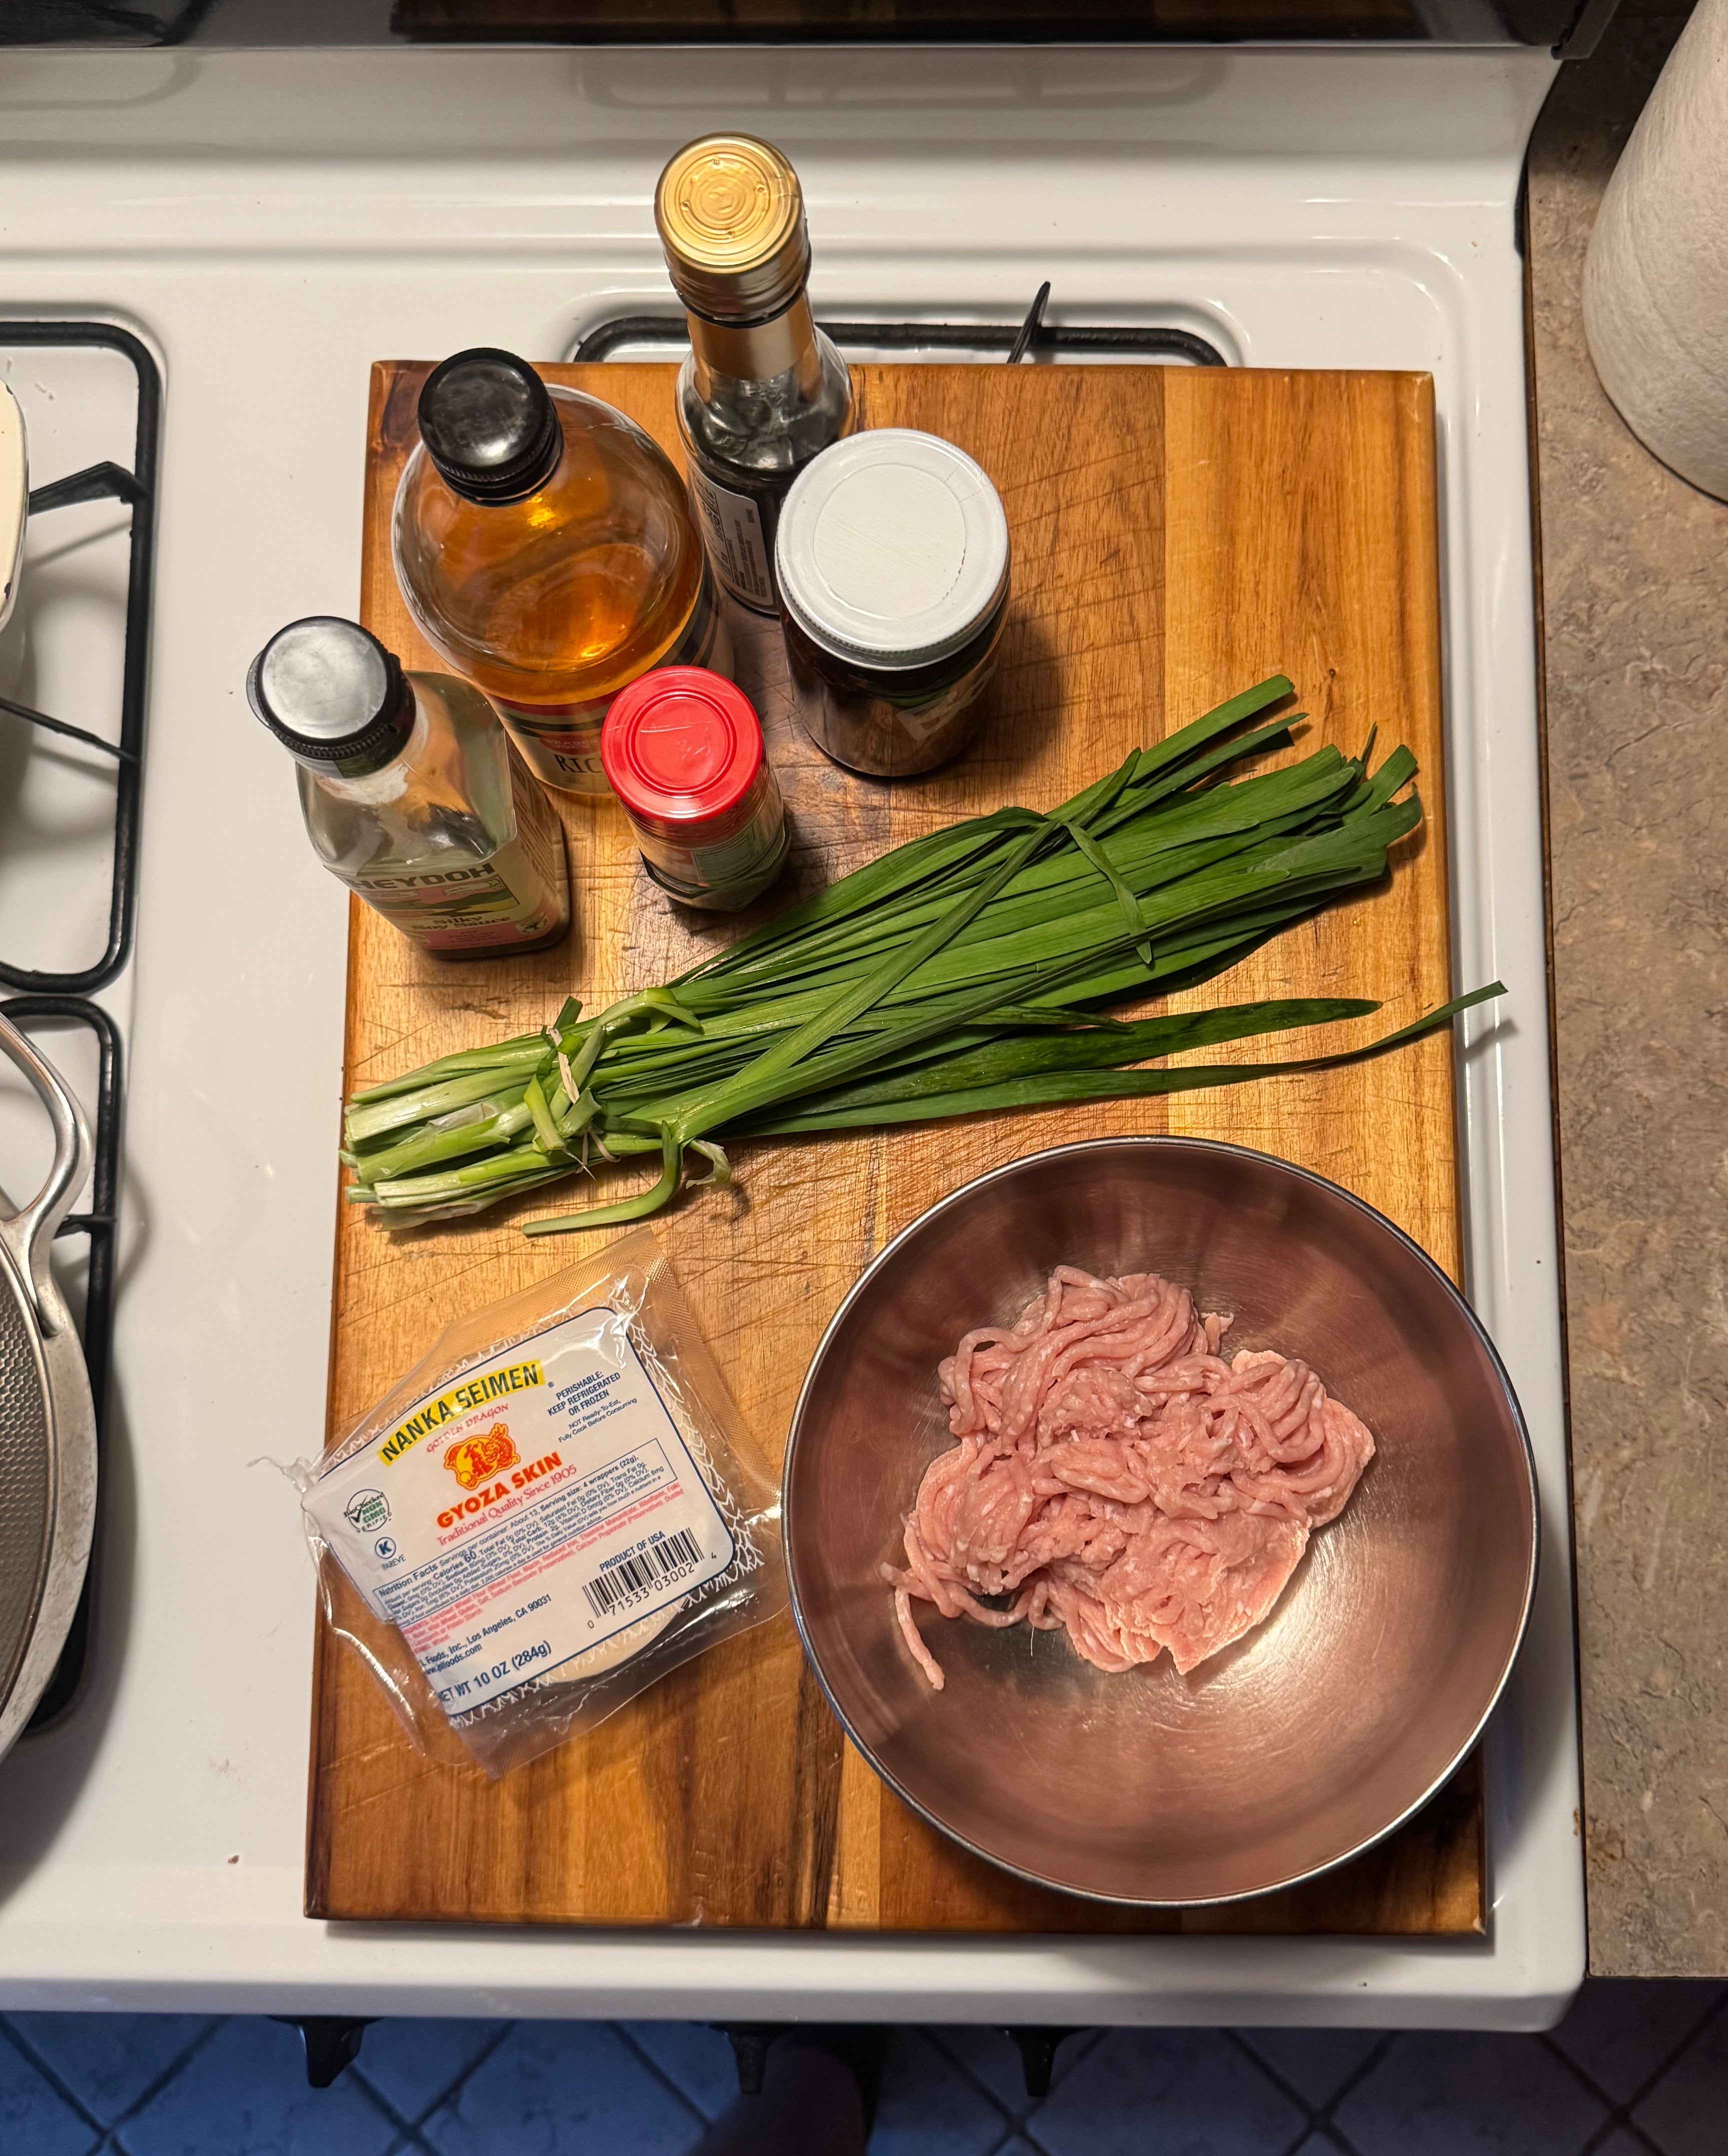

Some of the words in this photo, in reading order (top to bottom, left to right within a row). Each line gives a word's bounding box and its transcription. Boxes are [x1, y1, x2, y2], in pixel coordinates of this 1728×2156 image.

[554, 754, 604, 773] RIC
[346, 862, 496, 890] HEYDOH
[433, 916, 483, 926] Silky
[547, 1400, 567, 1416] KEEP
[567, 1372, 621, 1406] REFRIGERATED
[555, 1370, 604, 1400] PERISHABLE:
[382, 1400, 455, 1462] NANKA
[454, 1364, 538, 1410] SEIMEN
[464, 1403, 509, 1428] DRAGON
[568, 1404, 580, 1416] OR
[580, 1389, 610, 1410] FROZEN
[568, 1418, 582, 1430] NOT
[582, 1398, 621, 1422] Ready-To-Eat,
[558, 1432, 573, 1444] Fully
[572, 1424, 587, 1435] Cook
[587, 1414, 606, 1426] Before
[606, 1397, 637, 1418] Consuming
[435, 1480, 511, 1530] GYOZA
[509, 1450, 563, 1489] SKIN
[361, 1500, 383, 1516] NON
[362, 1506, 387, 1524] GMO
[436, 1512, 489, 1546] Traditional
[486, 1493, 525, 1522] Quality
[522, 1478, 552, 1500] Since
[549, 1464, 578, 1485] 1905
[356, 1511, 393, 1534] VERIFIED
[378, 1574, 413, 1598] Nutrition
[412, 1562, 439, 1580] Facts
[439, 1548, 468, 1568] Servings
[467, 1542, 480, 1553] per
[509, 1514, 529, 1528] About
[540, 1494, 567, 1512] Serving
[566, 1484, 583, 1497] size:
[588, 1464, 620, 1486] wrappers
[526, 1529, 548, 1544] Protein
[378, 1540, 393, 1556] K
[381, 1553, 407, 1572] PAREVE
[598, 1546, 637, 1572] PRODUCT
[635, 1539, 649, 1552] OF
[647, 1529, 666, 1546] USA
[432, 1560, 464, 1580] Calories
[586, 1619, 595, 1630] 0
[608, 1586, 651, 1616] 71533
[652, 1561, 696, 1592] 03002
[709, 1550, 718, 1560] 4
[425, 1647, 450, 1667] Foods,
[448, 1638, 468, 1655] Inc.,
[465, 1630, 482, 1644] Los
[480, 1612, 517, 1638] Angeles,
[514, 1606, 528, 1618] CA
[527, 1593, 552, 1612] 90031
[453, 1678, 474, 1698] WT
[472, 1670, 492, 1690] 10
[489, 1660, 512, 1680] OZ
[509, 1638, 554, 1672] (284g)
